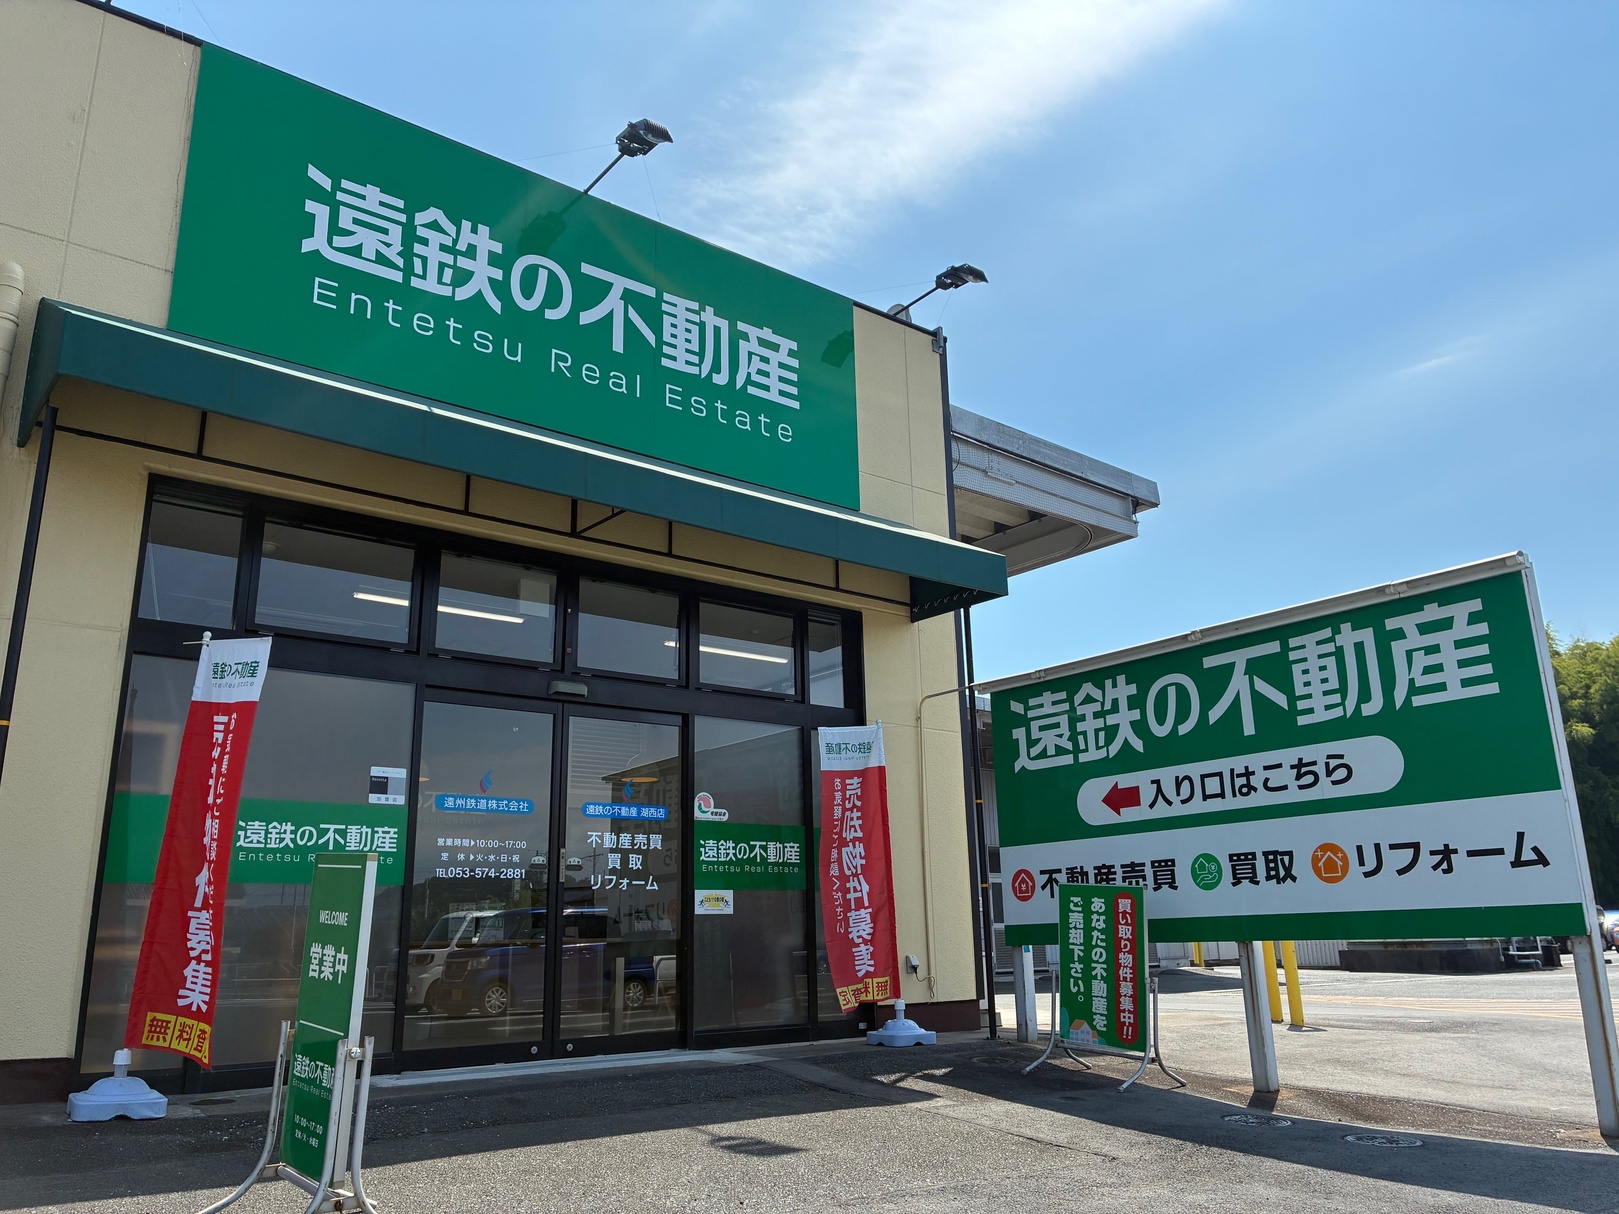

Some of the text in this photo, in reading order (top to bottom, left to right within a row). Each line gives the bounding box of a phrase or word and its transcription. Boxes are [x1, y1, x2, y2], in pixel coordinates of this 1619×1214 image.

[301, 162, 800, 410] 遠鉄の不動産
[313, 277, 793, 443] Entetsu Real Estate
[1010, 598, 1500, 773] 遠鉄の不動産
[1148, 753, 1354, 810] 入り口はこちら
[444, 796, 529, 812] 遠州鉄道株式会社
[585, 804, 665, 818] 遠鉄の不動産 湖西店
[236, 820, 398, 852] 遠鉄の不動産
[587, 831, 663, 850] 不動産売買
[700, 839, 800, 863] 遠鉄の不動産
[238, 852, 300, 862] Entetsu
[607, 853, 643, 870] 買取
[702, 864, 741, 872] Entetsu
[768, 865, 799, 873] Estate
[1039, 831, 1551, 898] 不動産売買 買取 リフォーム
[590, 875, 659, 891] リフォーム
[319, 909, 348, 926] WELCOME
[308, 942, 348, 984] 営業中
[1068, 896, 1085, 1002] ご売却下さい。
[1090, 897, 1107, 1031] あなたの不動産を
[1118, 899, 1134, 1039] 買い取り物件募集中!!
[145, 1015, 209, 1058] 無料査
[293, 1053, 335, 1089] 遠鉄の不動
